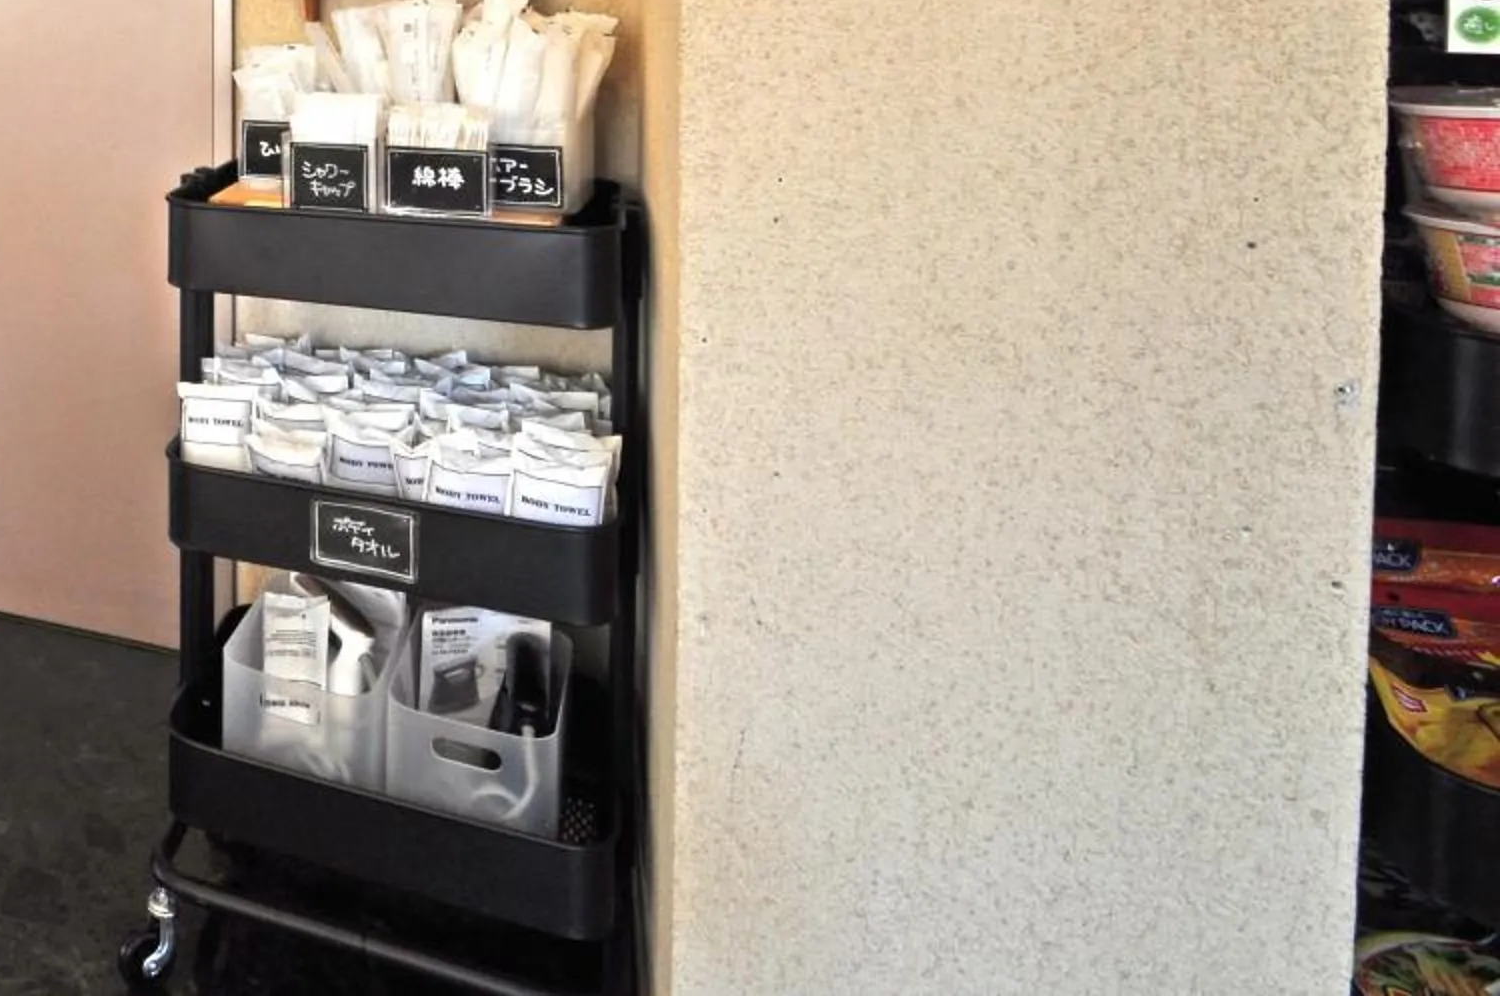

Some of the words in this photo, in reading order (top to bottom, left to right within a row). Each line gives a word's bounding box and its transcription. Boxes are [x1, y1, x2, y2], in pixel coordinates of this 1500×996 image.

[301, 161, 351, 179] シャワー
[496, 157, 529, 173] アー
[411, 166, 466, 191] 綿棒
[499, 175, 554, 196] ブラシ
[309, 180, 356, 198] キャップ
[367, 460, 393, 470] TOWE
[332, 516, 375, 536] ボディ
[351, 536, 400, 558] タオル
